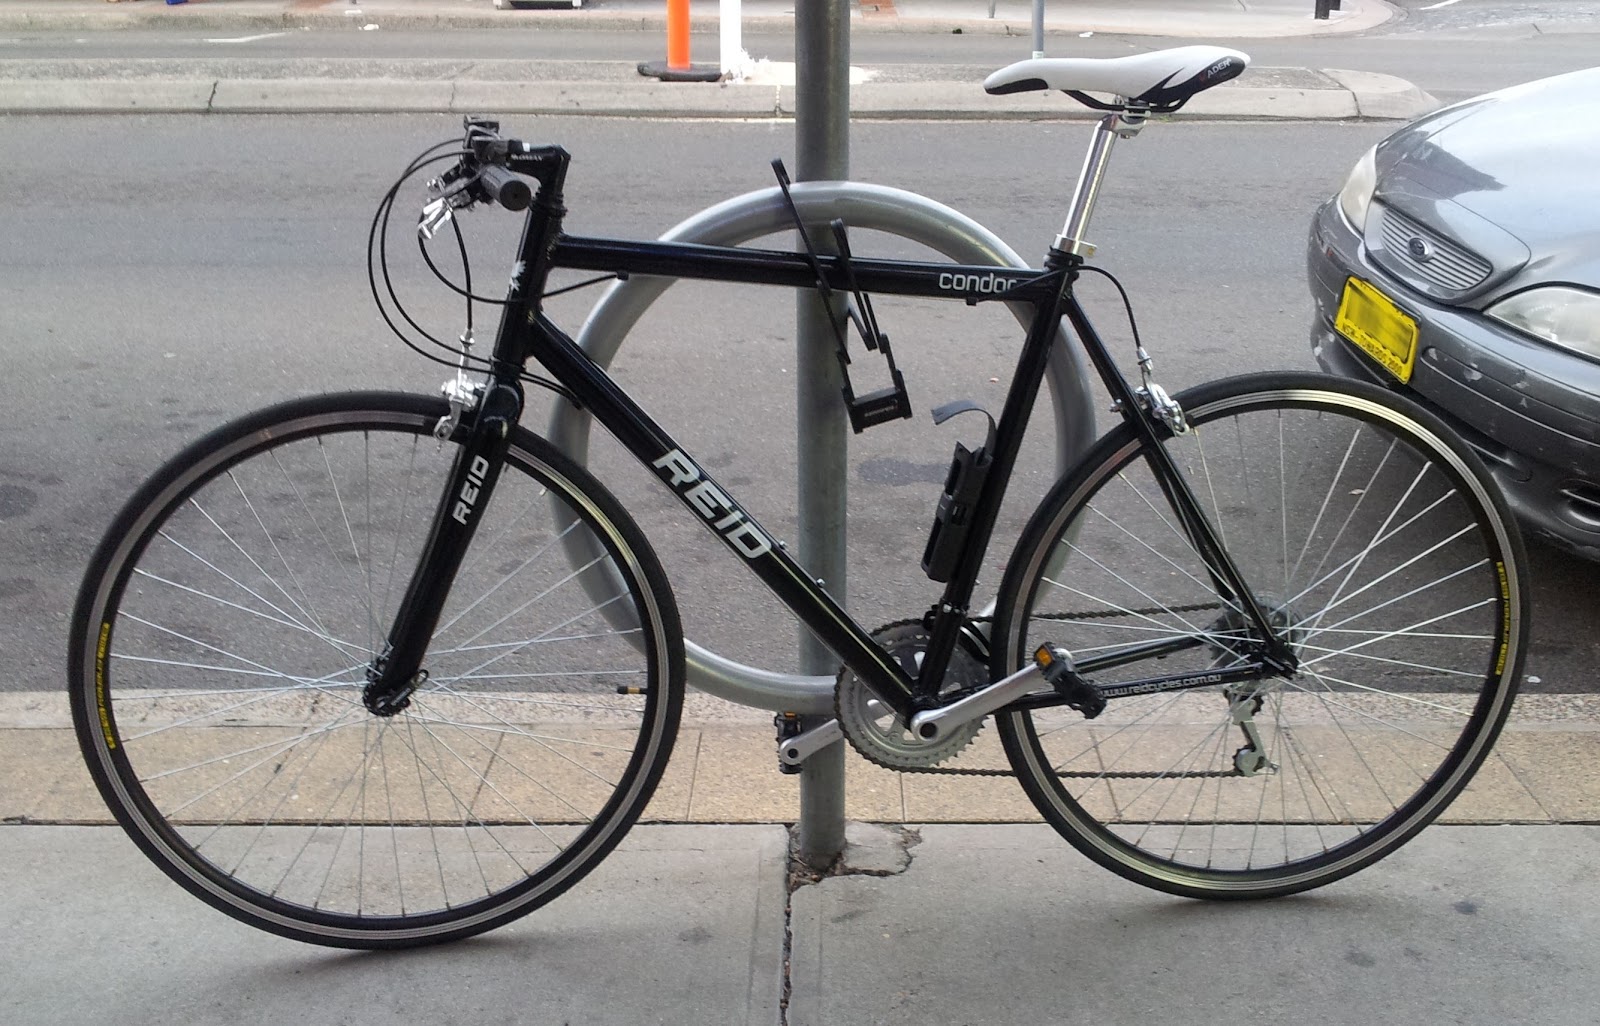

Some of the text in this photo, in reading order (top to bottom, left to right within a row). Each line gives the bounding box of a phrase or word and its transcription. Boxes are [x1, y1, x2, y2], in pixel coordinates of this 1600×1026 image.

[939, 273, 1018, 293] condor
[452, 455, 489, 525] REID
[653, 449, 771, 558] REID
